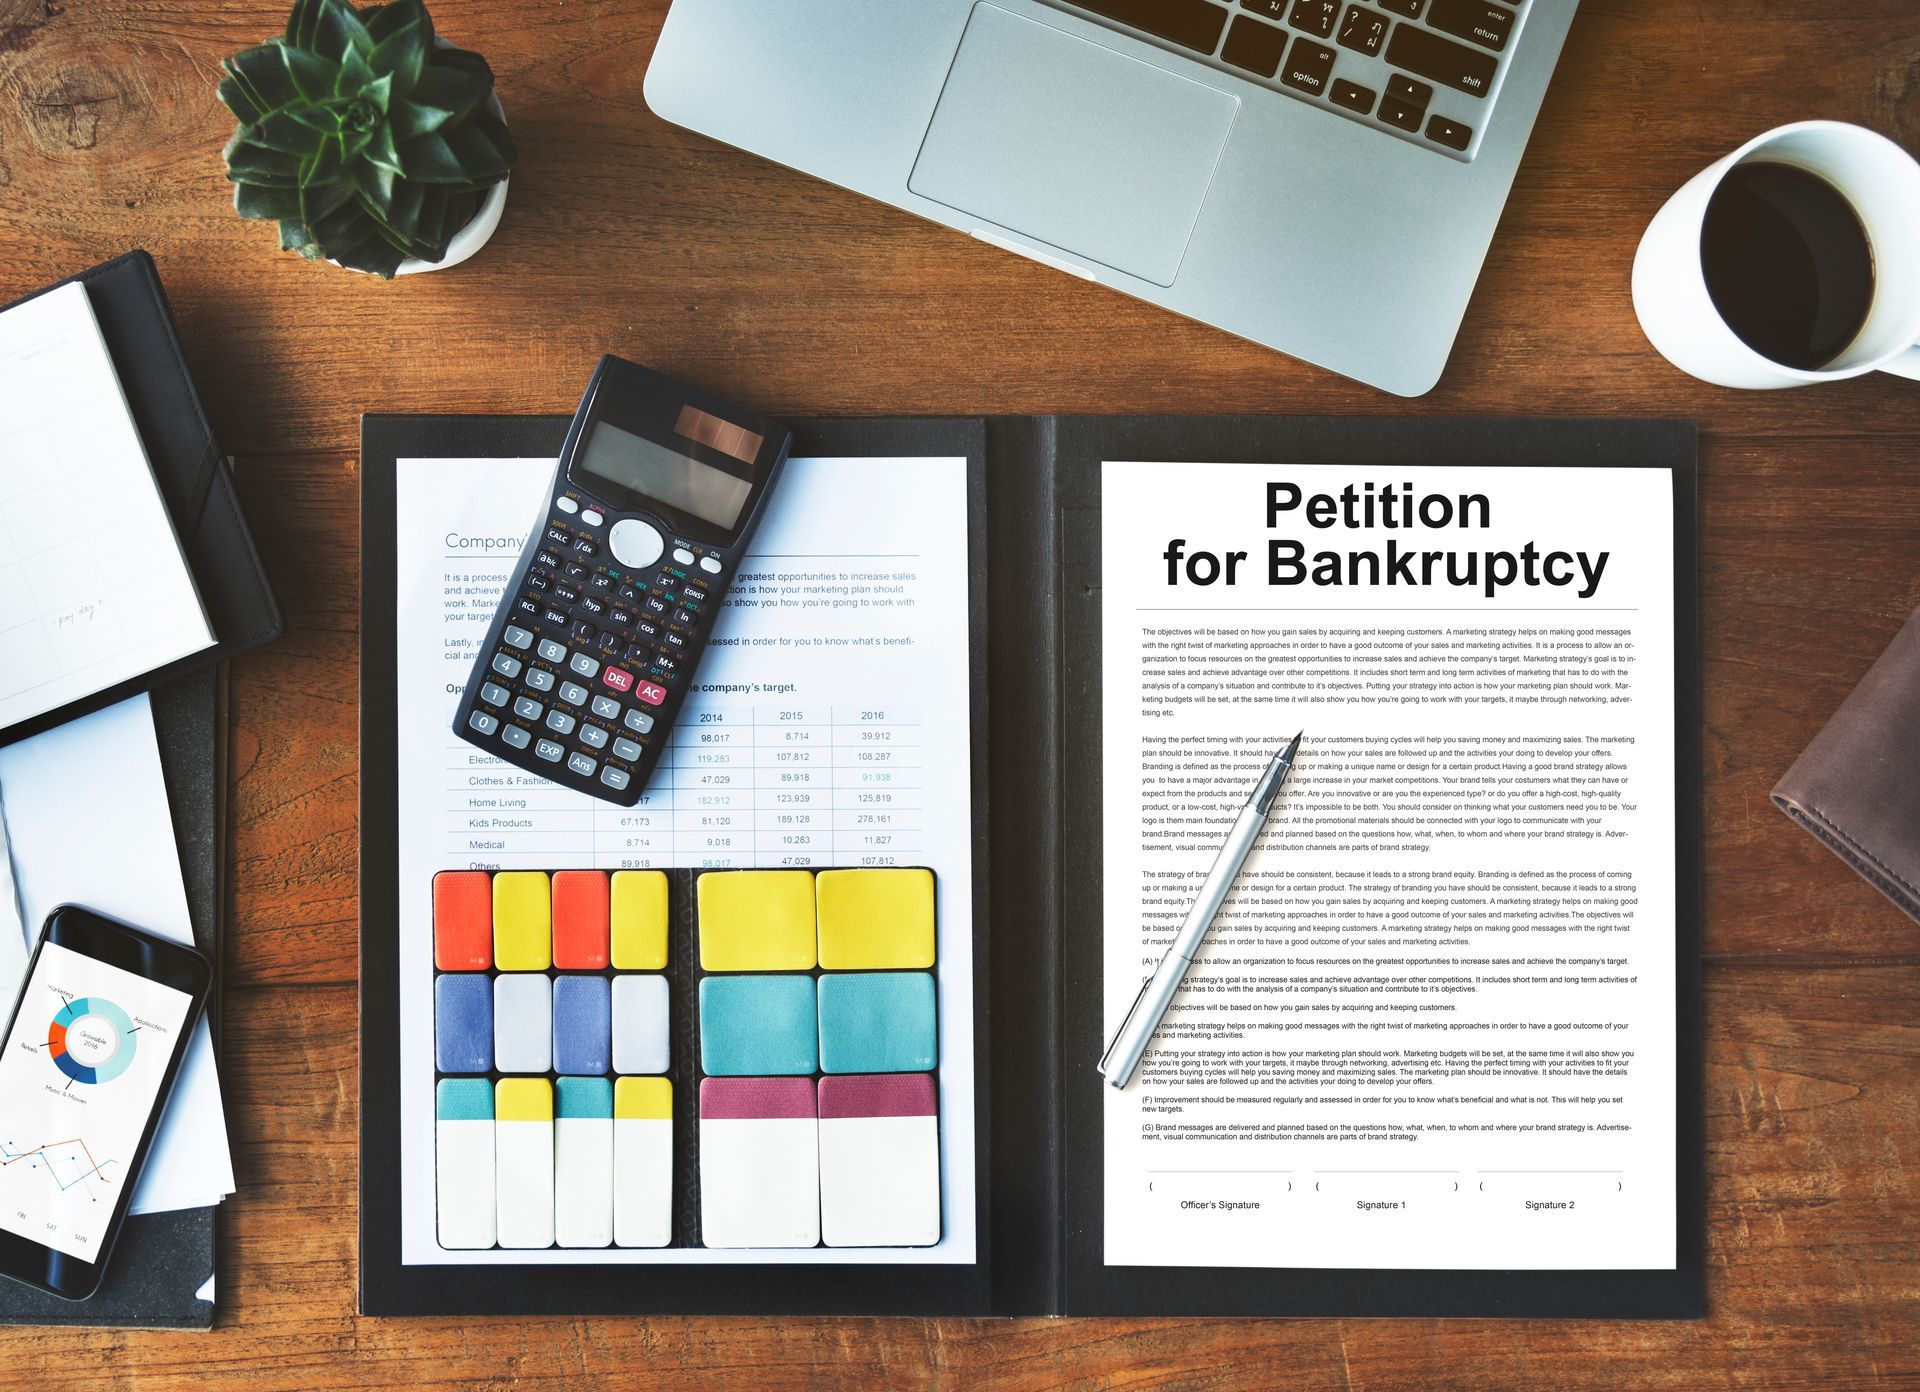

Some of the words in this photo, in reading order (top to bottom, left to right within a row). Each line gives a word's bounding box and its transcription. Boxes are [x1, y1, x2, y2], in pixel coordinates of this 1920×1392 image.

[1487, 10, 1506, 22] enter
[1473, 26, 1499, 42] return
[1319, 52, 1329, 61] alt
[1293, 70, 1320, 87] option
[1462, 75, 1481, 89] shift
[588, 503, 606, 514] ALPHA
[1267, 482, 1490, 529] Petition
[549, 530, 568, 543] CALC
[674, 539, 692, 550] MODE
[710, 551, 721, 559] ON
[671, 569, 687, 579] LOGIC
[1163, 539, 1248, 586] for
[1269, 540, 1610, 598] Bankruptcy
[445, 573, 450, 581] It
[453, 574, 461, 582] is
[472, 575, 508, 583] process
[738, 573, 775, 583] greatest
[778, 572, 836, 582] opportunities
[444, 586, 461, 594] and
[464, 586, 500, 595] achieve
[749, 585, 756, 594] is
[759, 585, 778, 594] how
[781, 585, 801, 596] your
[804, 585, 848, 595] marketing
[851, 585, 870, 595] plan
[873, 585, 903, 593] should
[685, 588, 705, 600] CONST
[521, 601, 536, 613] RCL
[585, 599, 601, 612] hyp
[650, 599, 664, 612] log
[734, 598, 758, 607] show
[761, 600, 778, 608] you
[780, 598, 799, 607] how
[802, 598, 830, 608] you're
[832, 599, 858, 608] going
[872, 598, 893, 606] work
[897, 598, 914, 606] with
[445, 614, 465, 622] your
[467, 613, 493, 622] target
[547, 612, 565, 624] ENG
[615, 613, 627, 623] sin
[680, 612, 689, 622] ln
[641, 624, 655, 634] cos
[1157, 629, 1192, 637] objectives
[1282, 629, 1297, 637] gain
[1319, 629, 1327, 637] by
[1329, 629, 1360, 637] acquiring
[1378, 629, 1405, 637] keeping
[1453, 629, 1487, 637] marketing
[1489, 629, 1516, 637] strategy
[1518, 629, 1537, 637] helps
[1550, 629, 1575, 637] making
[1576, 629, 1594, 637] good
[445, 638, 473, 648] Lastly,
[742, 637, 750, 646] in
[752, 637, 777, 645] order
[779, 637, 791, 645] for
[794, 639, 811, 647] you
[825, 637, 849, 645] know
[852, 637, 880, 645] what's
[883, 637, 914, 645] benefi-
[515, 631, 524, 643] 7
[669, 635, 683, 646] tan
[445, 651, 460, 659] cial
[547, 646, 557, 656] 8
[501, 660, 512, 671] 4
[579, 660, 590, 671] 9
[659, 657, 674, 669] M+
[535, 674, 545, 685] 5
[608, 672, 627, 687] DEL
[568, 688, 578, 699] 6
[642, 687, 661, 700] AC
[702, 683, 760, 694] company's
[763, 684, 797, 694] target.
[492, 689, 499, 700] 1
[523, 702, 533, 714] 2
[479, 717, 488, 728] 0
[555, 716, 565, 728] 3
[700, 714, 722, 722] 2014
[780, 712, 803, 720] 2015
[861, 712, 884, 720] 2016
[701, 734, 729, 743] 98,017
[786, 732, 809, 741] 8,714
[862, 732, 890, 740] 39,912
[539, 742, 560, 757] EXP
[572, 757, 591, 770] Ans
[698, 755, 730, 764] 119,283
[777, 753, 809, 761] 107,812
[469, 777, 504, 785] Clothes
[507, 777, 513, 785] &
[701, 776, 730, 784] 47,029
[781, 772, 809, 781] 89,918
[862, 773, 891, 782] 91,938
[469, 798, 496, 807] Home
[500, 798, 526, 808] Living
[777, 794, 810, 803] 123,939
[859, 794, 891, 803] 125,819
[470, 819, 489, 827] Kids
[492, 819, 532, 827] Products
[621, 818, 650, 826] 67,173
[702, 817, 730, 825] 81,120
[777, 815, 810, 823] 189,128
[858, 815, 890, 823] 278,161
[470, 841, 504, 849] Medical
[626, 839, 649, 847] 8,714
[707, 838, 731, 846] 9,018
[783, 836, 810, 844] 10,283
[865, 836, 891, 844] 11,827
[469, 862, 500, 870] Others
[621, 860, 650, 868] 89,918
[702, 859, 731, 868] 98,017
[782, 857, 811, 866] 47,029
[861, 857, 894, 866] 107,812
[1158, 1106, 1184, 1114] targets.
[1181, 1201, 1216, 1209] Officer's
[1219, 1201, 1260, 1211] Signature
[1357, 1201, 1398, 1211] Signature
[1525, 1201, 1566, 1211] Signature
[1569, 1201, 1574, 1209] 2
